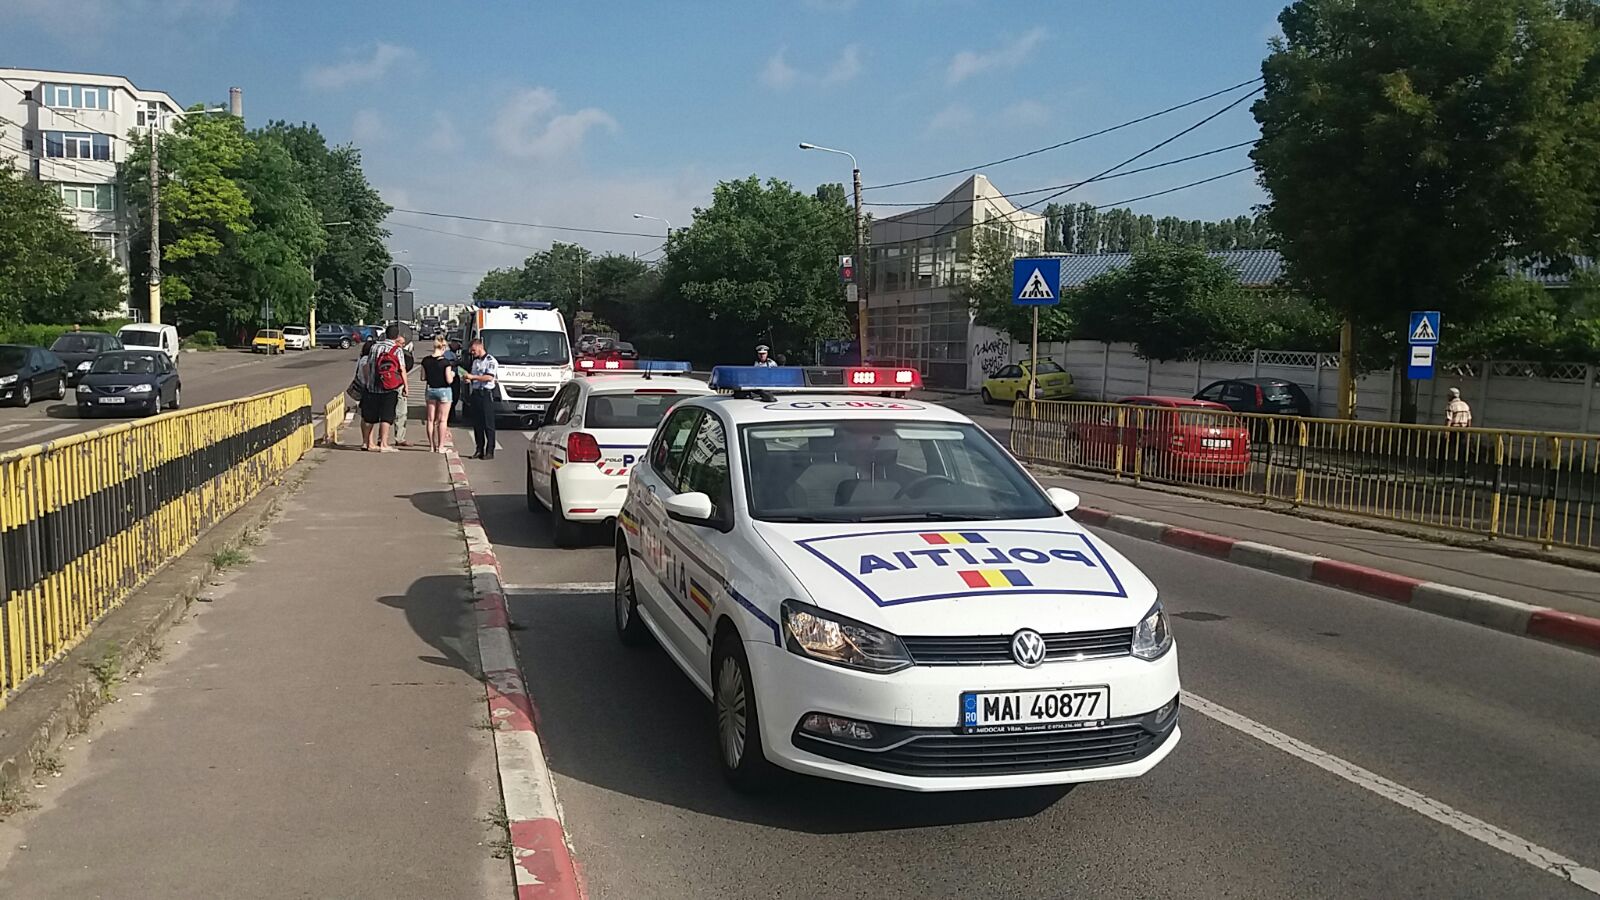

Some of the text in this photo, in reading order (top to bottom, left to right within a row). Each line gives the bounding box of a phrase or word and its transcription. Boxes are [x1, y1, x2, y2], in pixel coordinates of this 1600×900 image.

[984, 692, 1101, 721] MAI 40877
[965, 712, 977, 722] RO
